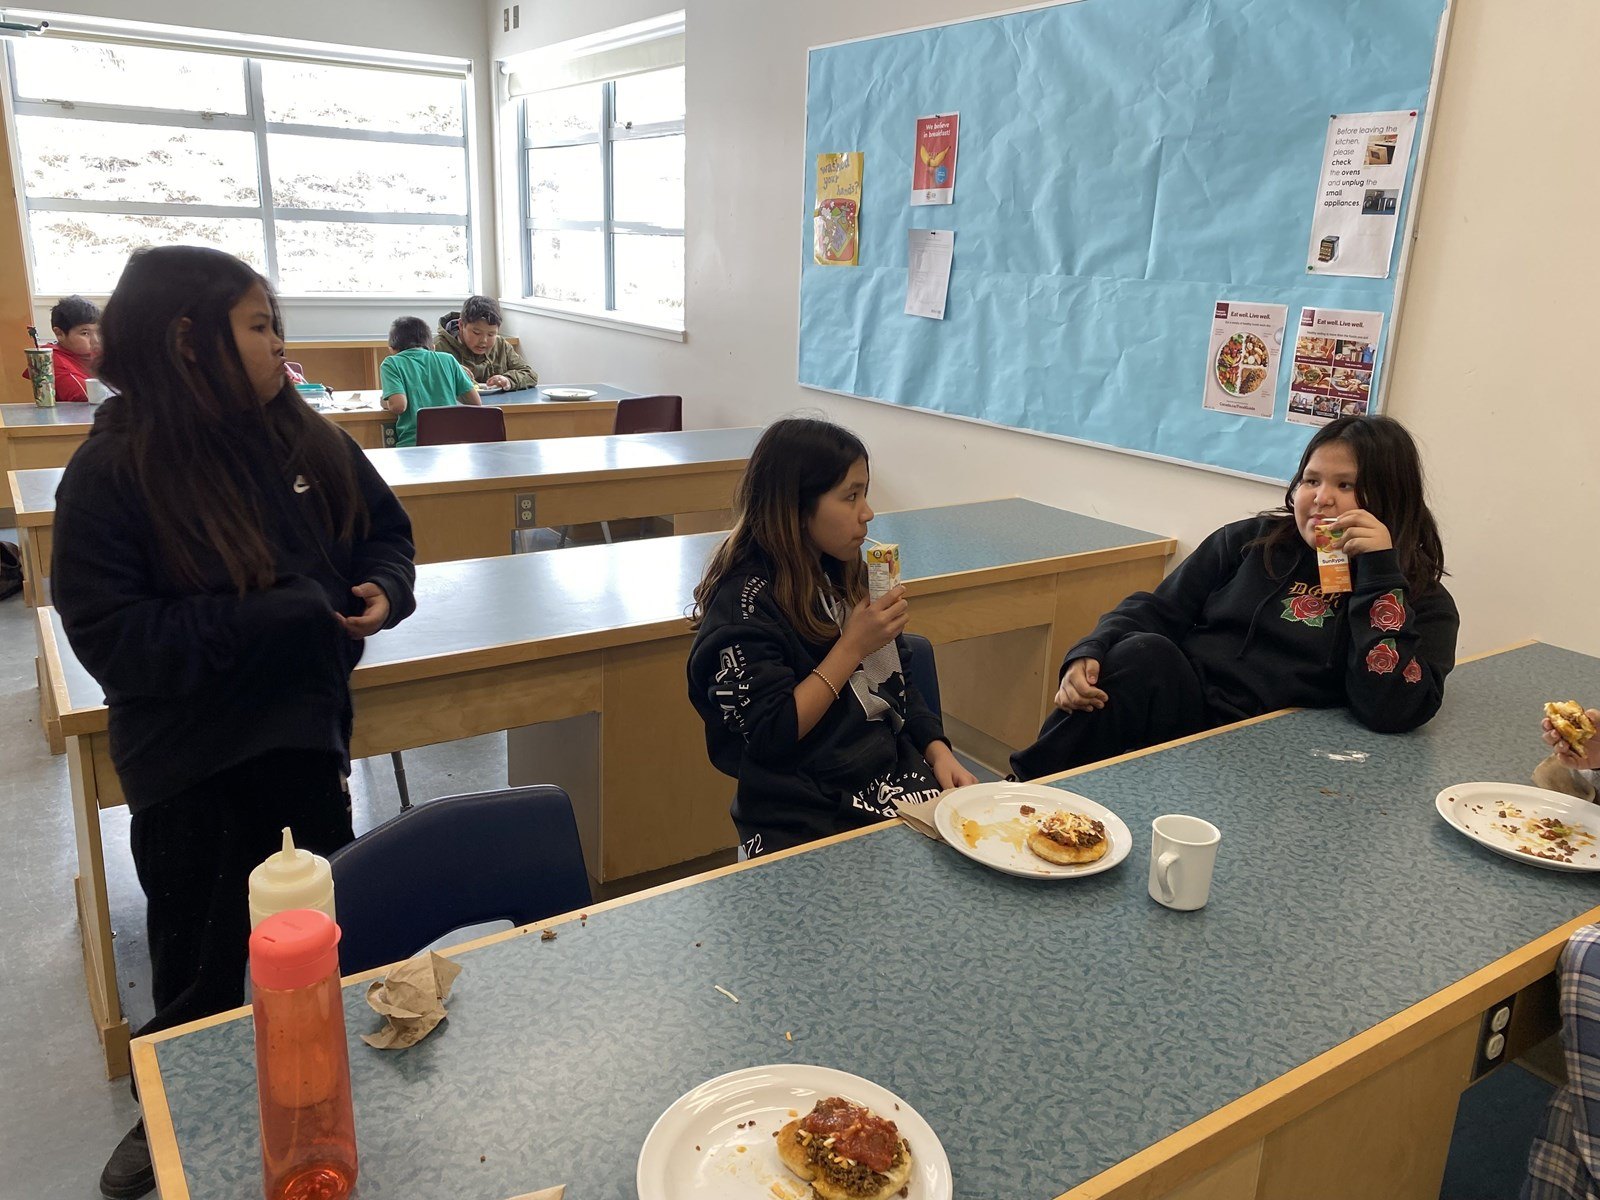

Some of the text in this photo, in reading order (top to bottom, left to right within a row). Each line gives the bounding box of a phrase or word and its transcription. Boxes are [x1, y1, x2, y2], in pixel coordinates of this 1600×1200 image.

[1359, 126, 1384, 134] leaving
[1333, 148, 1354, 157] please
[820, 160, 850, 174] washed
[823, 175, 839, 190] your
[837, 181, 859, 195] hands?
